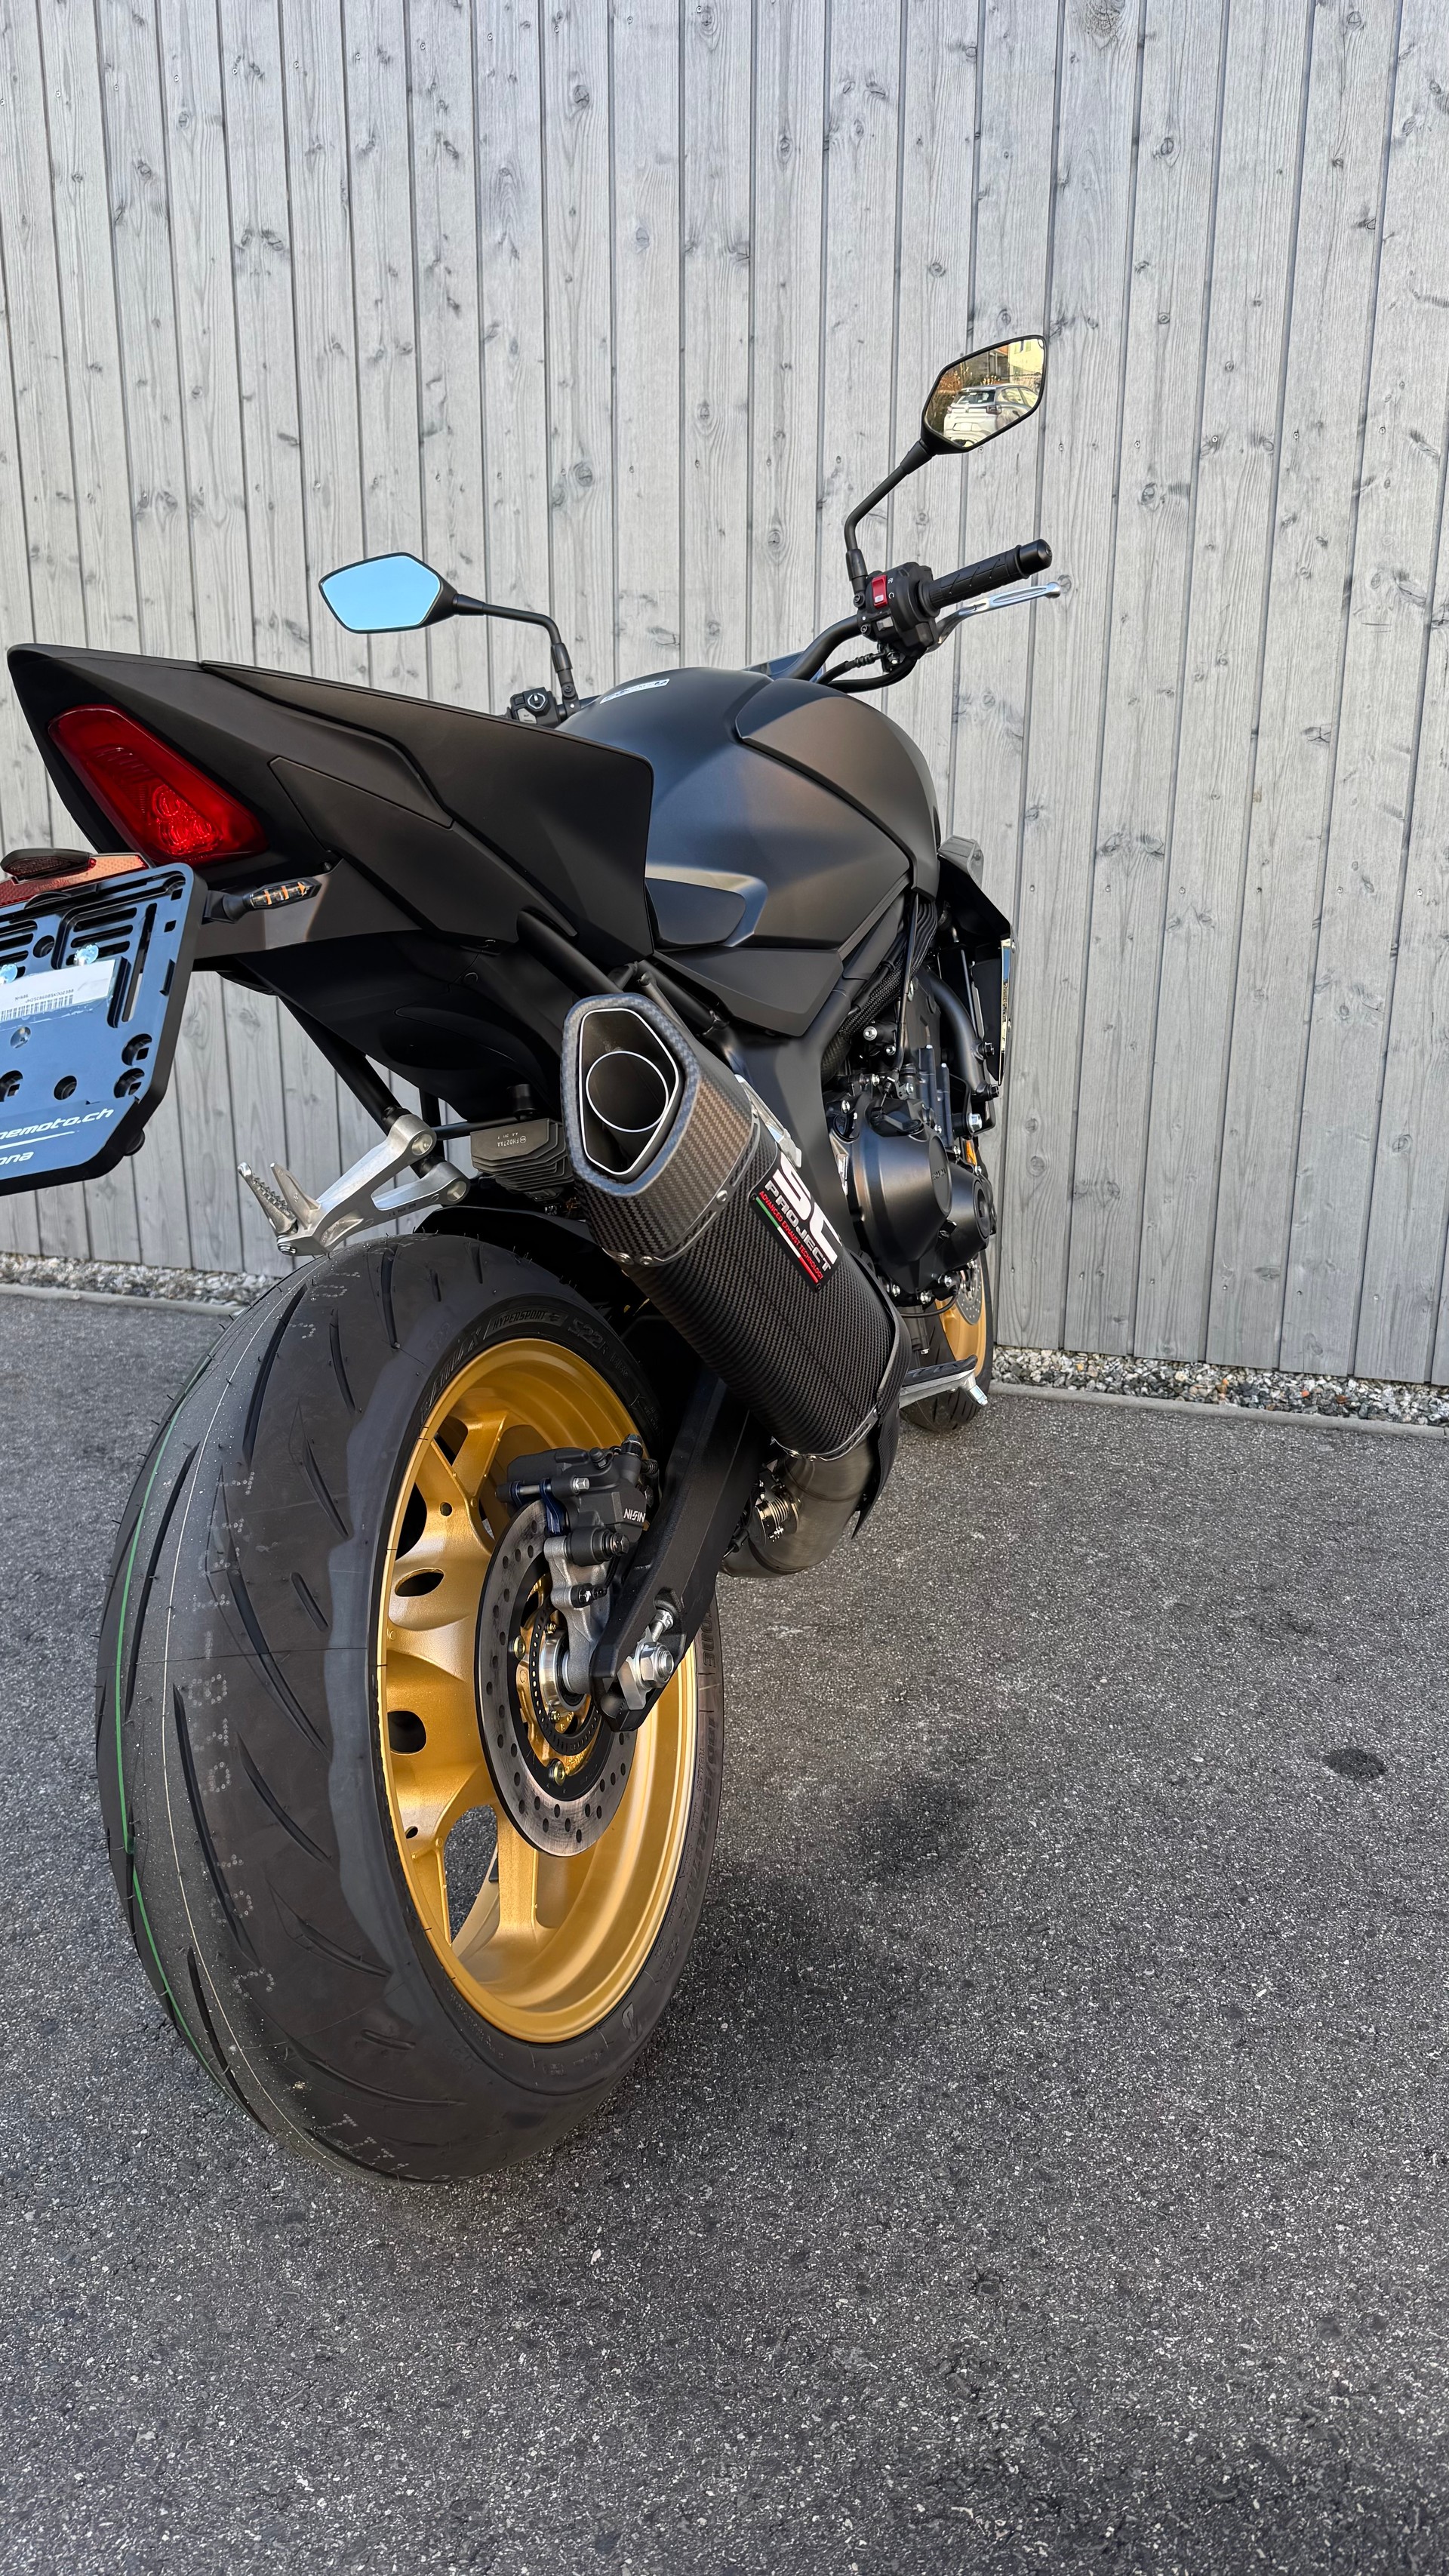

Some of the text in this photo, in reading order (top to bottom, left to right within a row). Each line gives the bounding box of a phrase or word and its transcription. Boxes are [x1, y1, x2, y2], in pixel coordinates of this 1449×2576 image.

[758, 1190, 824, 1280] ADVANCED EXHAUST TECHNOLOGY
[764, 1180, 832, 1273] PROJECT
[492, 1310, 548, 1331] HYPERSPORT
